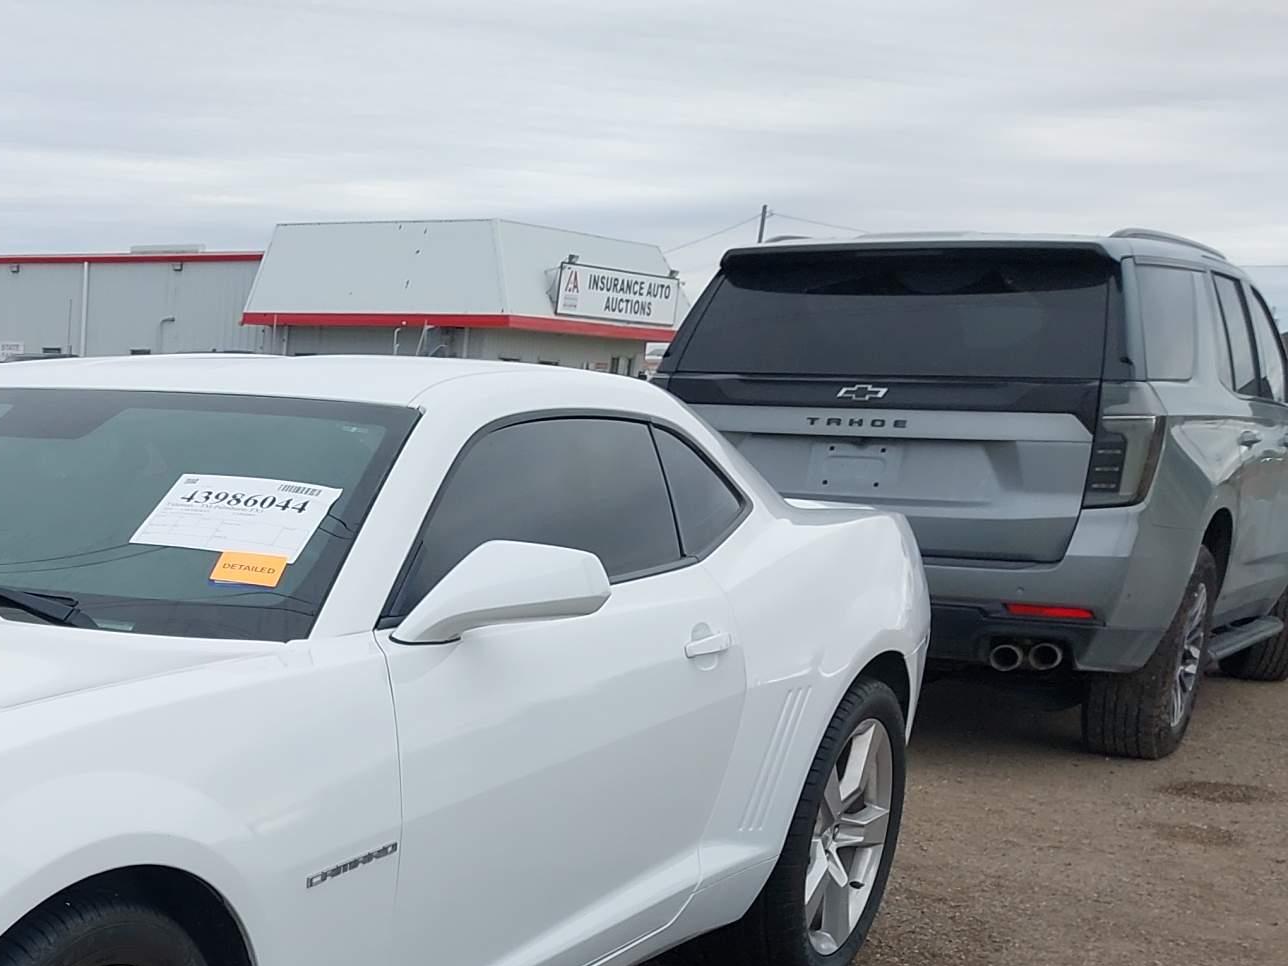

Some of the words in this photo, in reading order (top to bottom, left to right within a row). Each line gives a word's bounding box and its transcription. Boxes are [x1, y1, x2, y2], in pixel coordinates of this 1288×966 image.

[587, 274, 645, 297] INSURANCE
[646, 283, 672, 300] AUTO
[604, 296, 652, 317] AUCTIONS
[806, 416, 908, 429] TAHOE
[180, 489, 311, 514] 43986044
[222, 562, 276, 575] DETAILED
[306, 842, 398, 888] CAMARO
